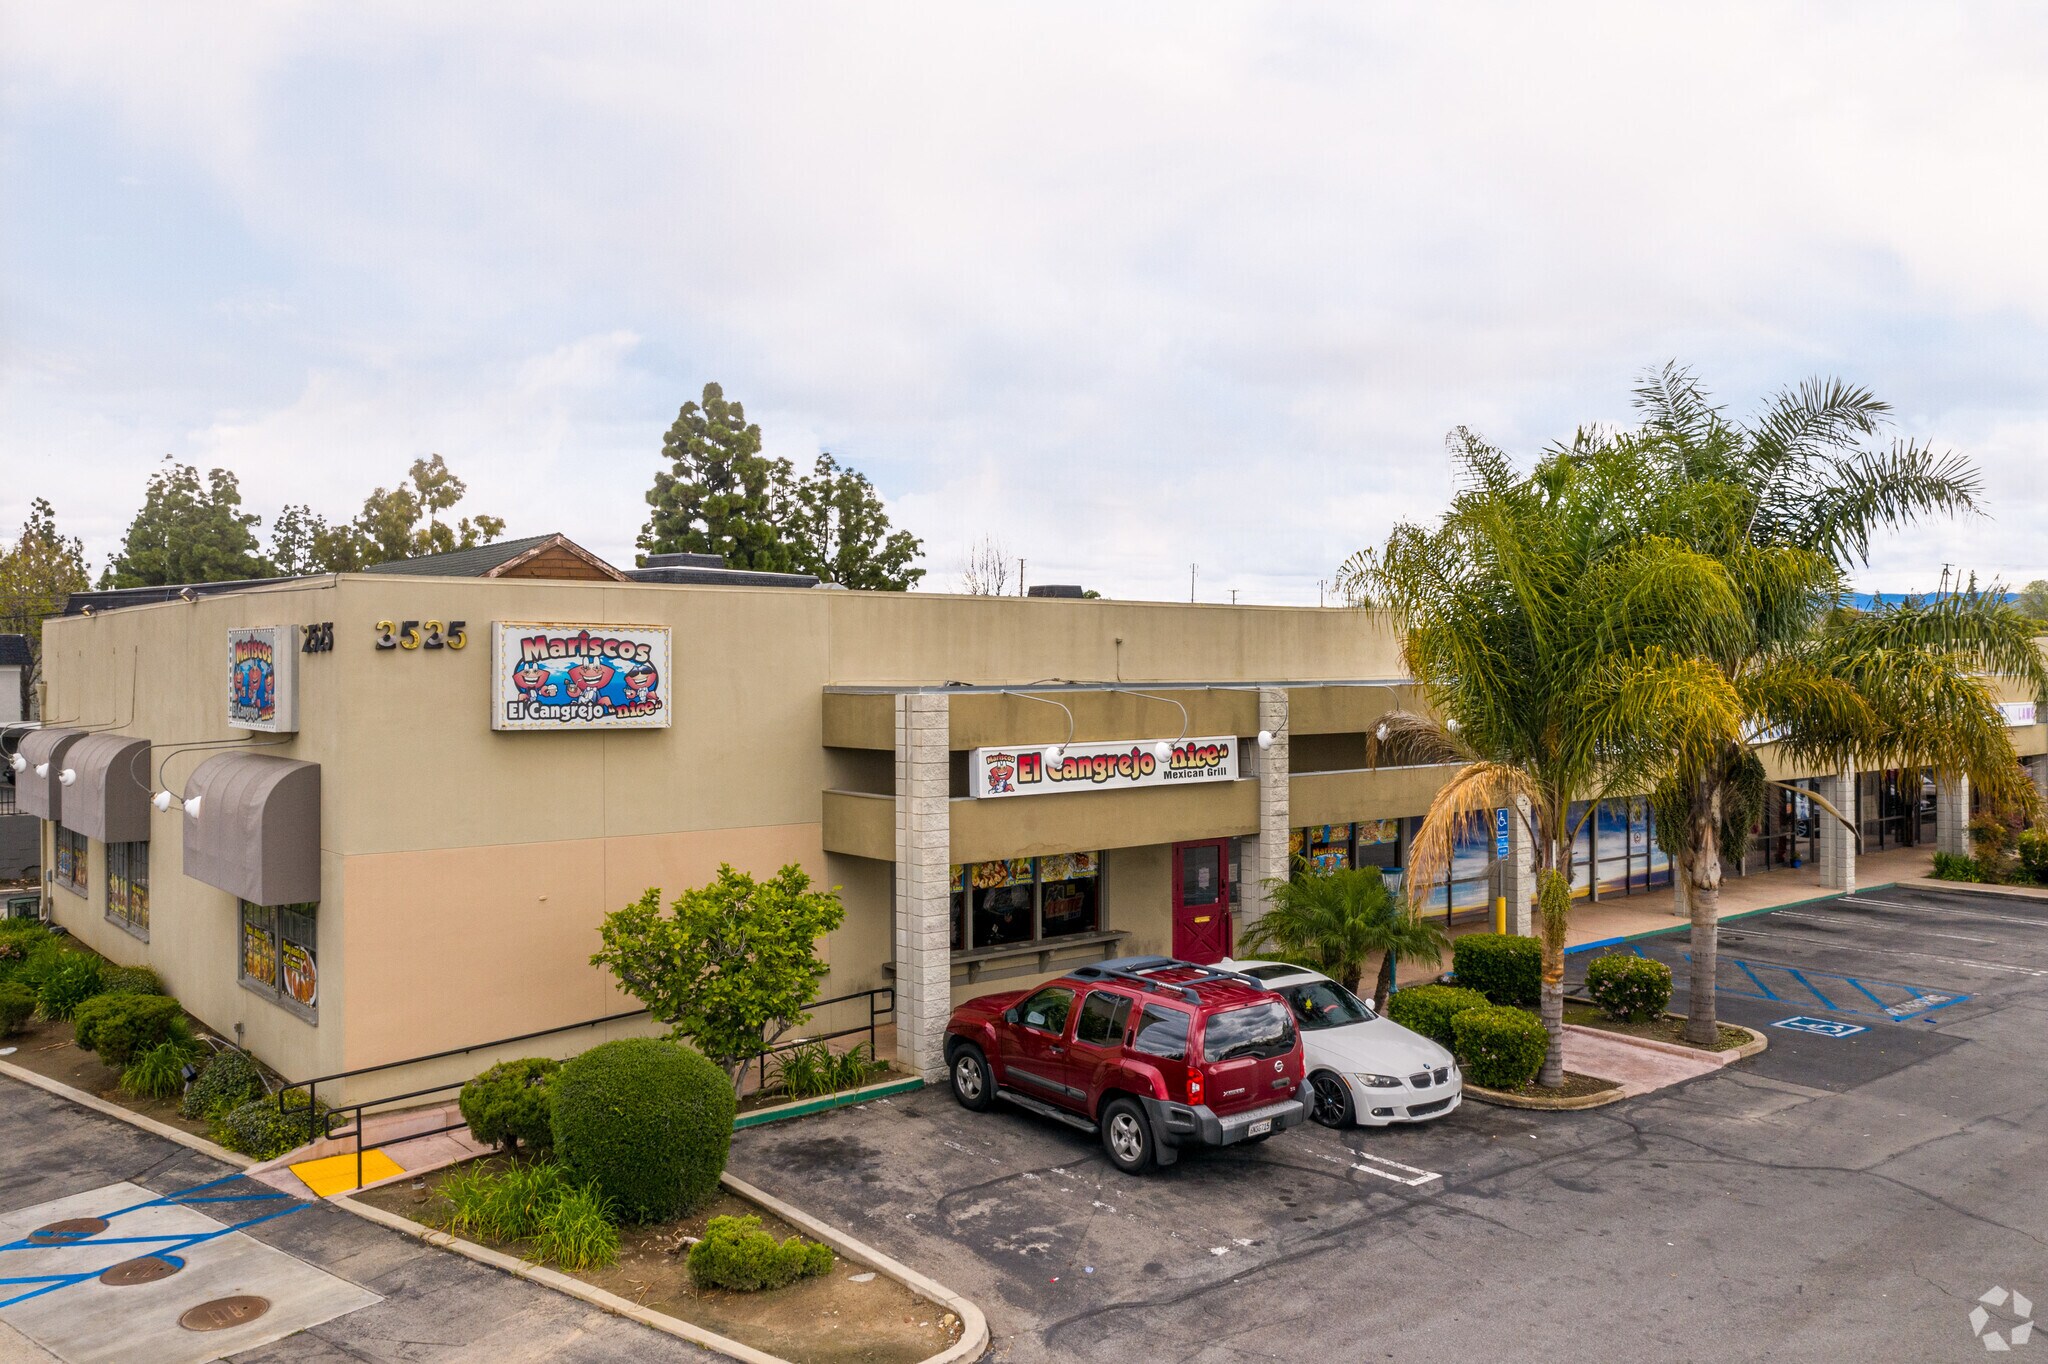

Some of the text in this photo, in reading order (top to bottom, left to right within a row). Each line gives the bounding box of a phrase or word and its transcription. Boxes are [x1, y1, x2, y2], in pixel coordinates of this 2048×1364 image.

[376, 620, 467, 651] 2525
[520, 630, 652, 664] Mariscos
[235, 633, 273, 665] Mariscos
[507, 702, 525, 720] El
[527, 701, 604, 722] Cangrejo
[986, 752, 1015, 765] Mariscos
[1017, 752, 1042, 784] El
[1163, 767, 1227, 780] Mexican Grill
[1312, 845, 1348, 857] Mariscos
